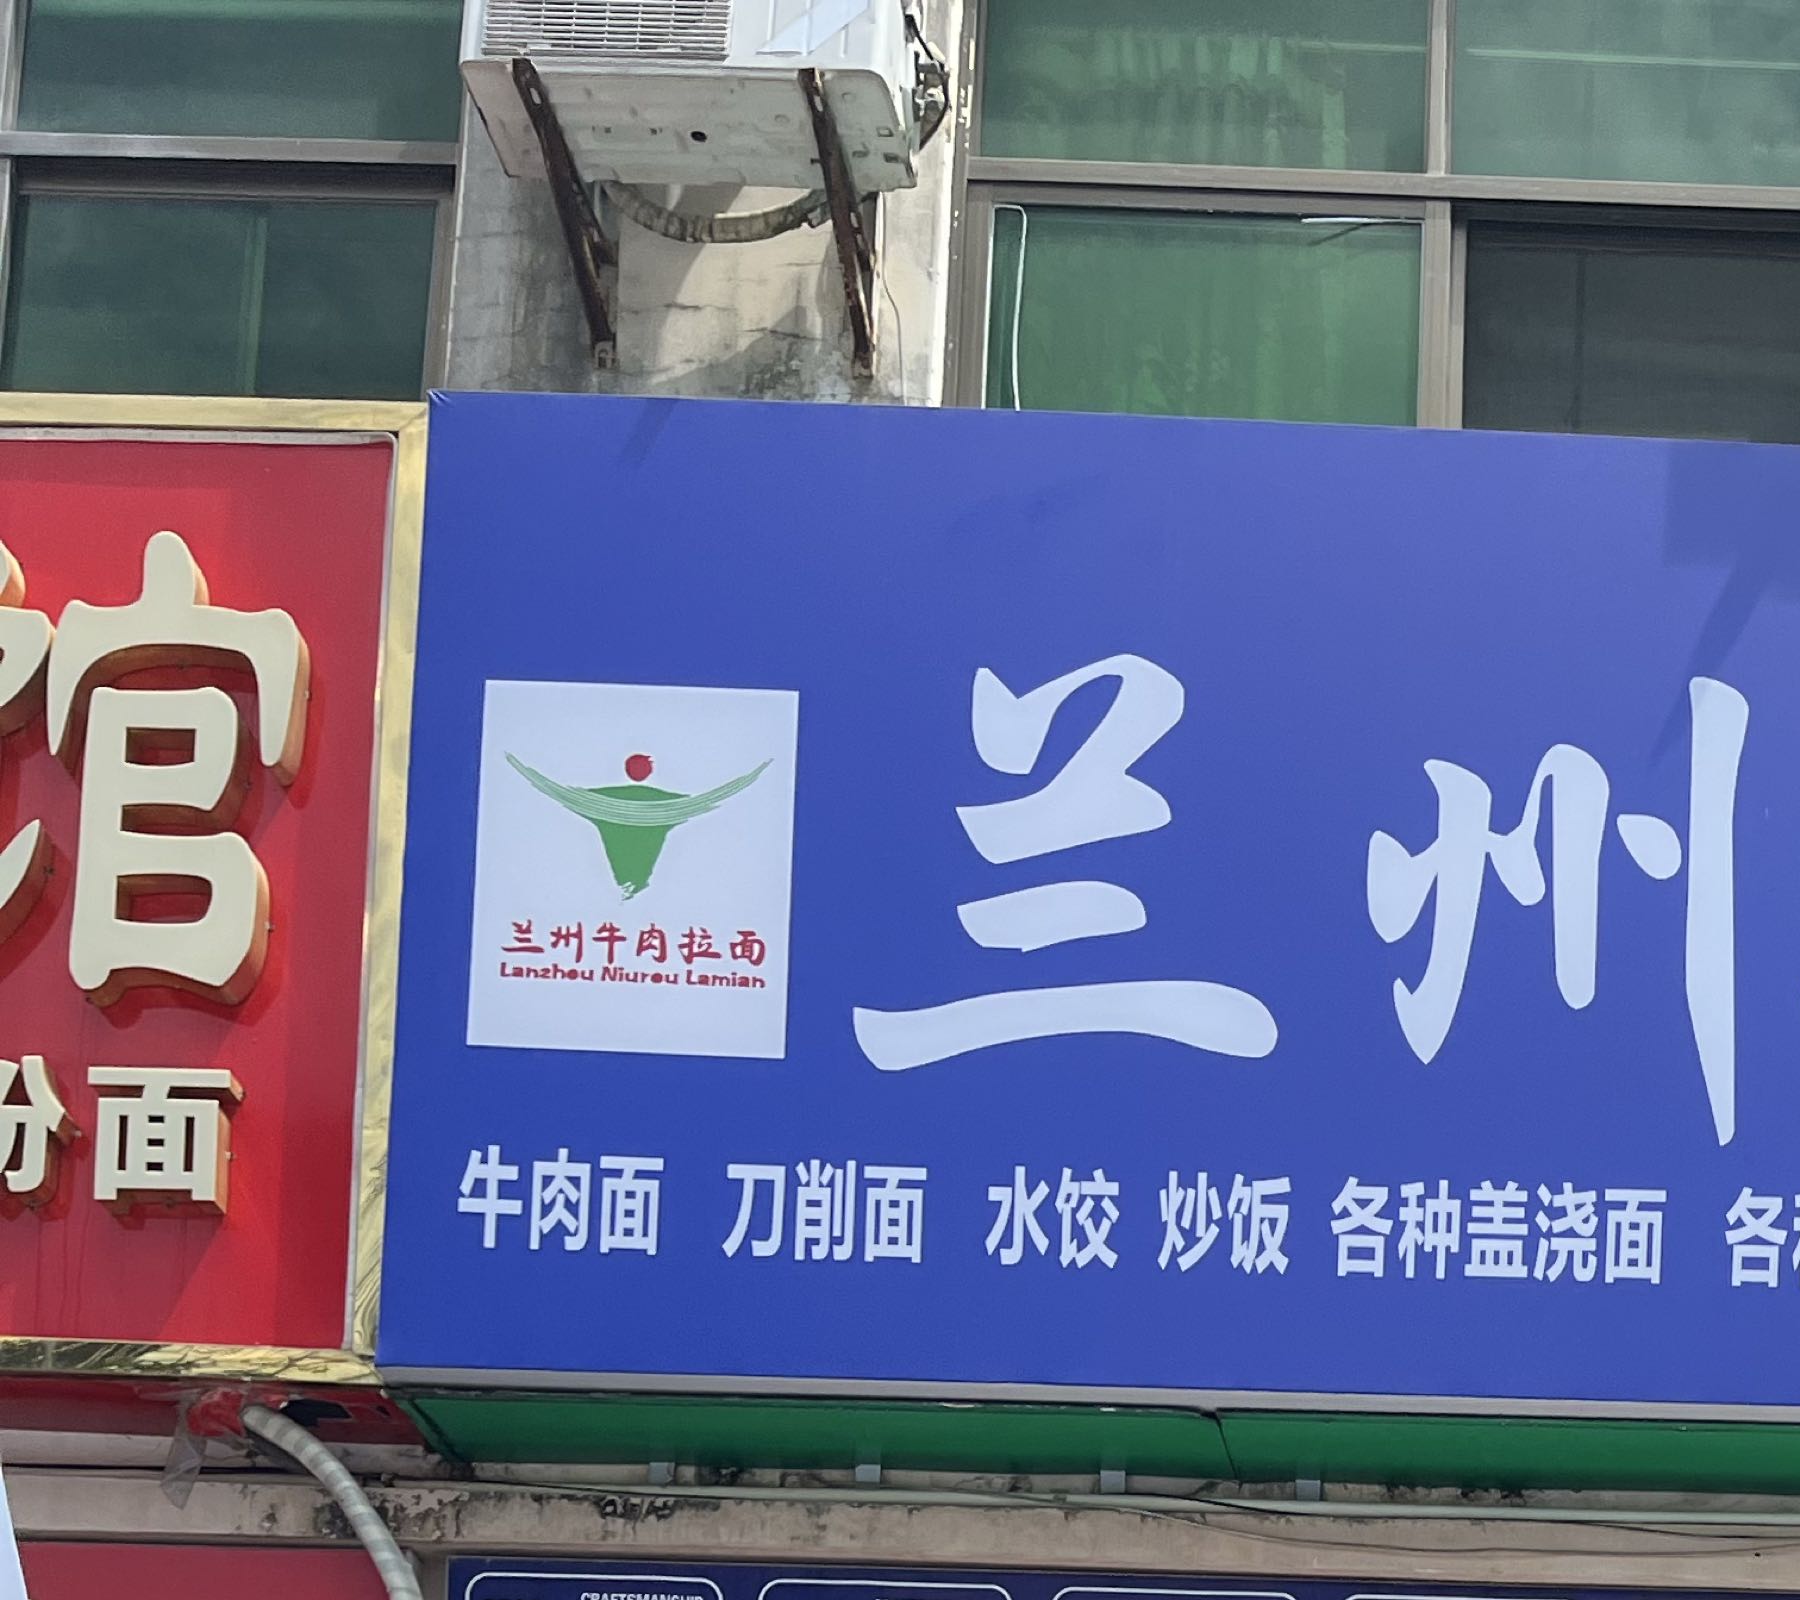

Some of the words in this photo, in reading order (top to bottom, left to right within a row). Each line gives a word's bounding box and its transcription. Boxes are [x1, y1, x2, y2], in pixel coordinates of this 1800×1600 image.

[501, 919, 767, 967] 兰州牛肉拉面
[501, 961, 594, 982] Lanzhou
[600, 966, 680, 985] Niurou
[686, 969, 767, 989] Lamian
[457, 1147, 666, 1259] 牛肉面
[722, 1158, 929, 1264] 刀削面
[984, 1166, 1121, 1272] 水饺
[1157, 1172, 1293, 1278] 炒饭
[1330, 1176, 1668, 1285] 各种盖浇面
